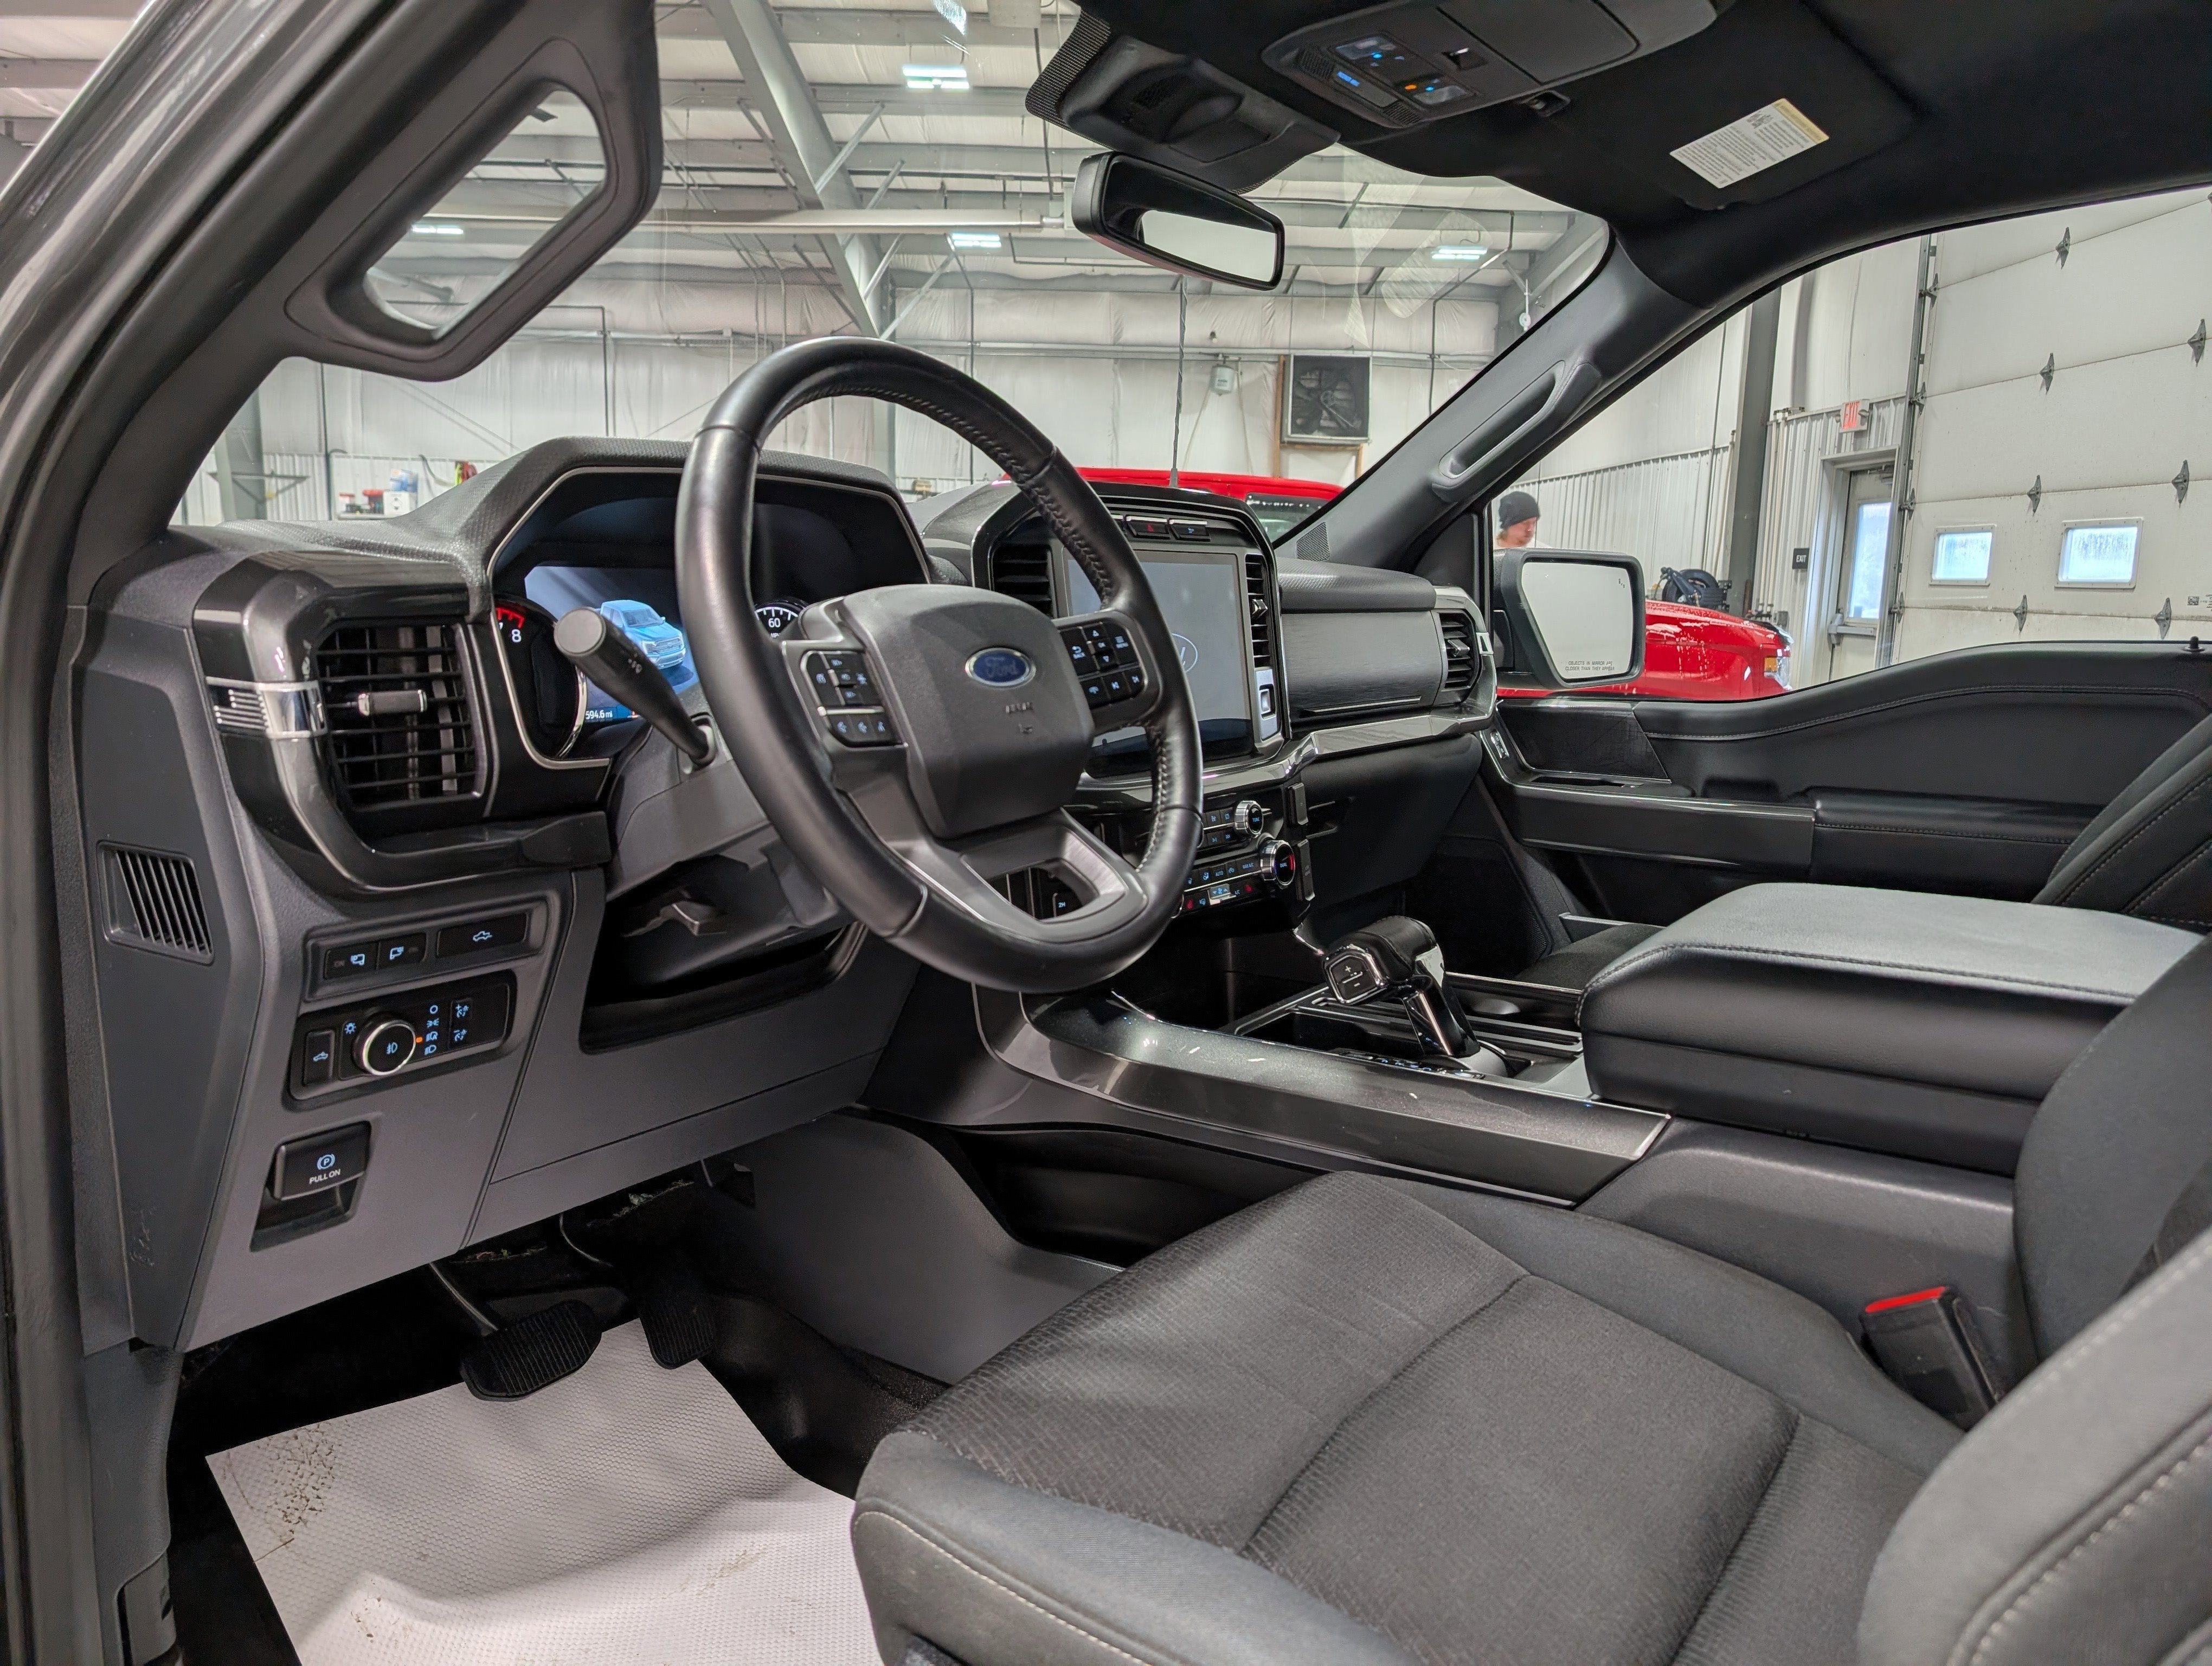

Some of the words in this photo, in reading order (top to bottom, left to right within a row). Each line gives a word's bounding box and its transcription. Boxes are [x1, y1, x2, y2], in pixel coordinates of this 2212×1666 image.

[1843, 401, 1860, 429] EXIT
[1796, 554, 1806, 562] EXIT
[768, 618, 781, 628] 60
[511, 629, 522, 643] 8
[309, 1173, 328, 1184] PULL
[329, 1169, 341, 1178] ON
